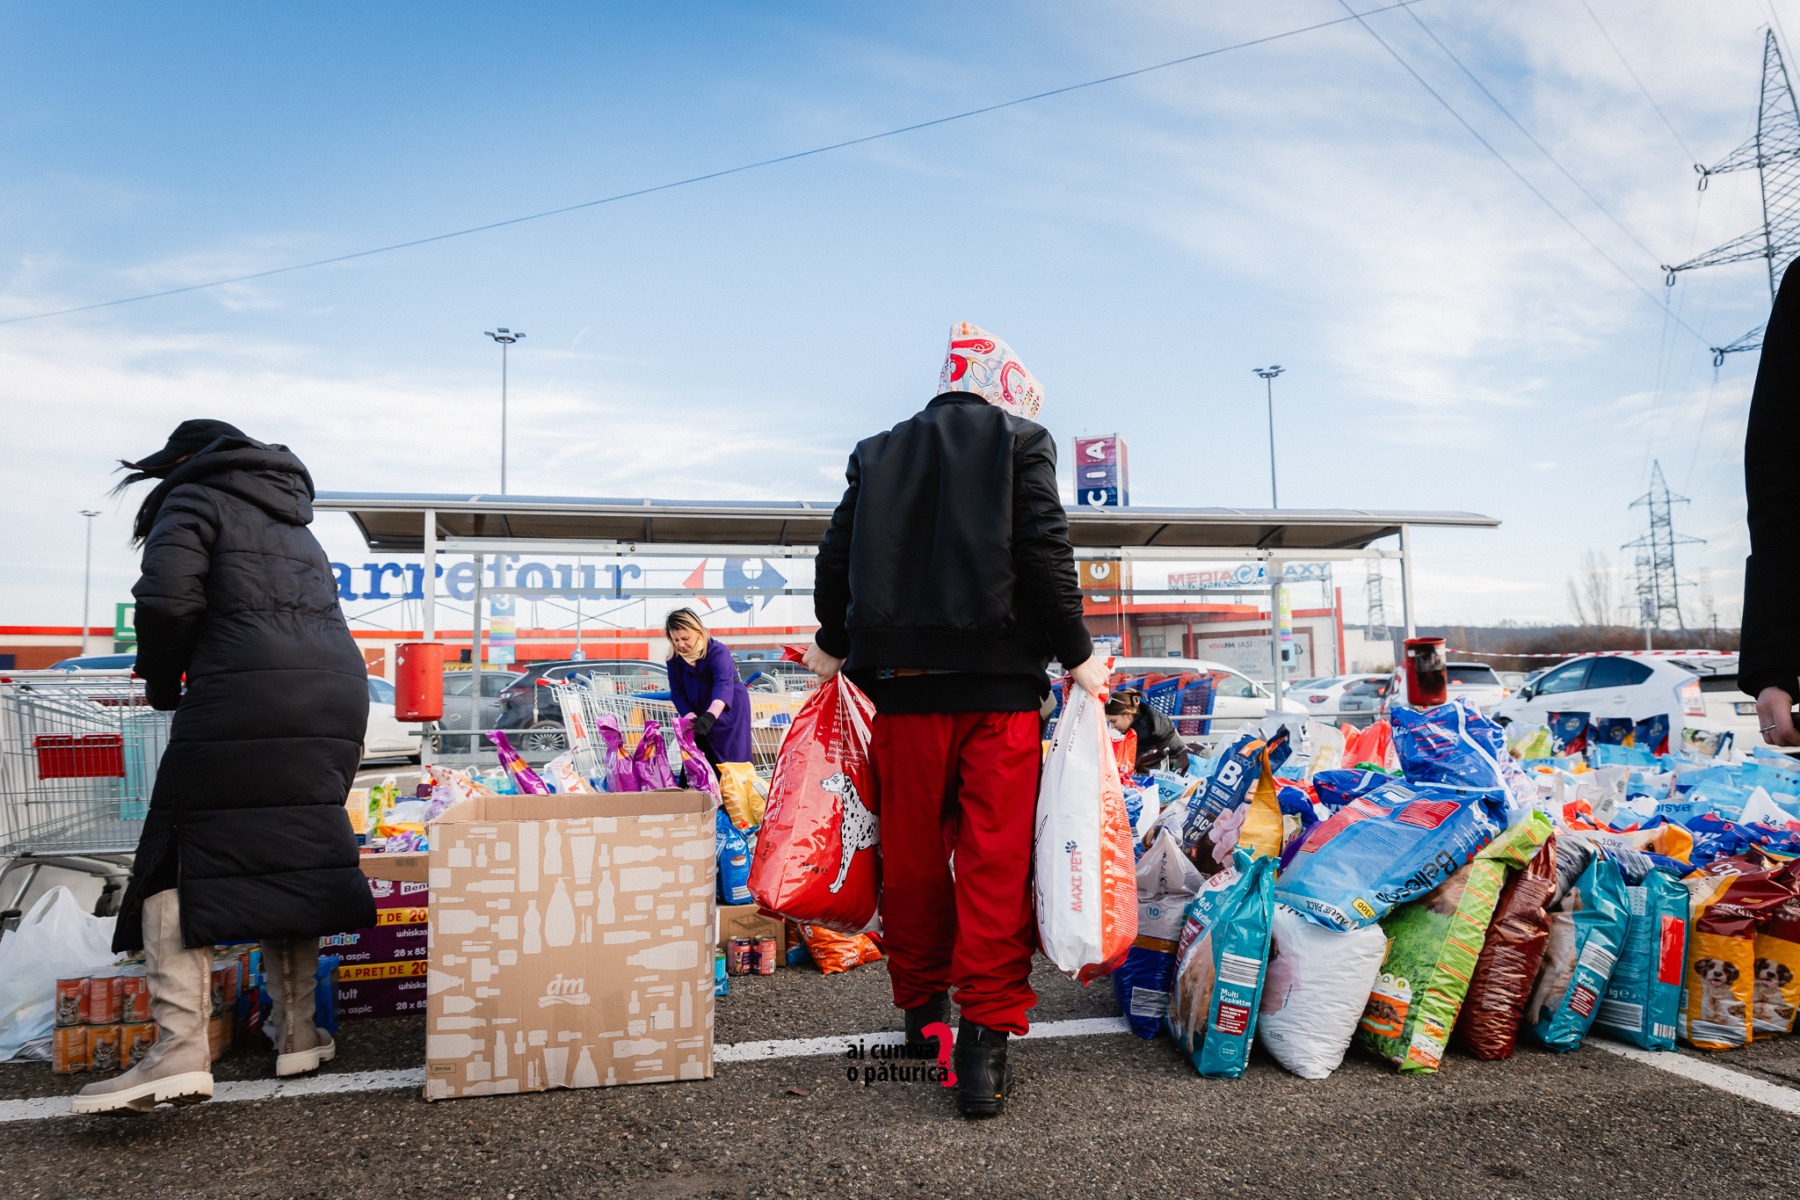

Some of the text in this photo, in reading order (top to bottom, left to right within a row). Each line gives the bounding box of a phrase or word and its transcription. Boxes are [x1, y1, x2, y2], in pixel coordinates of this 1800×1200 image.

[331, 553, 641, 602] arrefour
[1168, 570, 1234, 585] MEDIA
[1071, 850, 1083, 912] MAXI PET
[387, 913, 402, 923] DE
[409, 909, 427, 922] 20
[1149, 907, 1159, 916] 10
[1323, 907, 1349, 925] ALUE
[346, 952, 371, 961] aspic
[394, 949, 406, 958] 28
[389, 965, 404, 975] DE
[546, 973, 585, 995] dm
[338, 989, 358, 1000] ult
[1221, 988, 1239, 999] Multi
[348, 1005, 372, 1015] aspic
